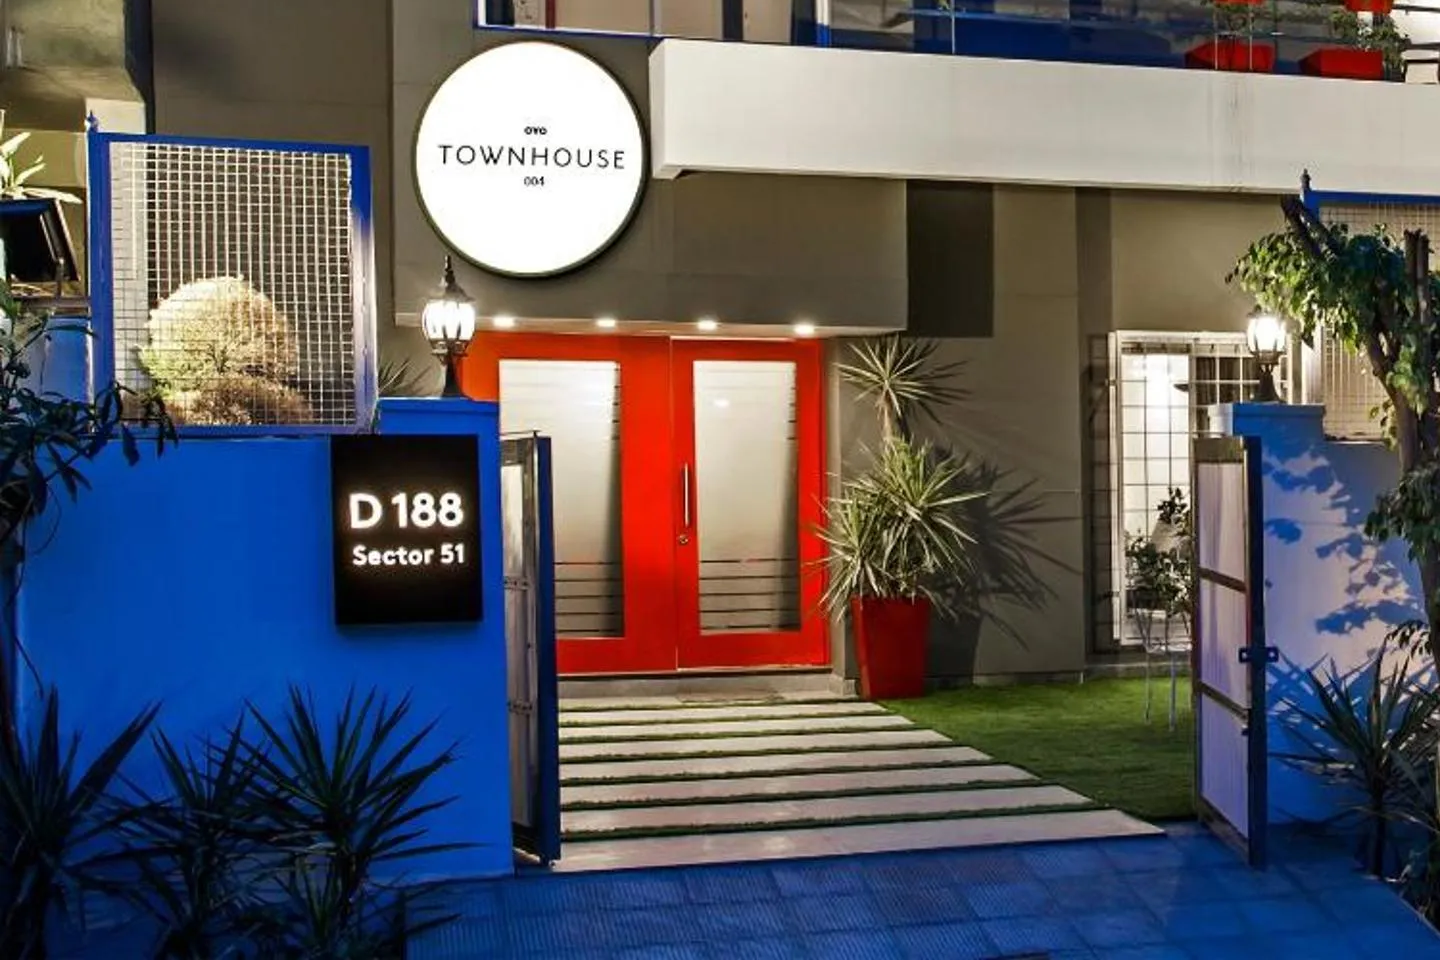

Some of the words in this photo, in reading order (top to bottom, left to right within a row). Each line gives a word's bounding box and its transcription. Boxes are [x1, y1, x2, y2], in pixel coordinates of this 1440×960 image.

[523, 125, 548, 136] OYO
[438, 144, 626, 170] TOWNHOUSE
[349, 492, 383, 529] D
[391, 492, 464, 529] 188
[352, 543, 435, 566] Sector
[440, 543, 465, 564] 51
